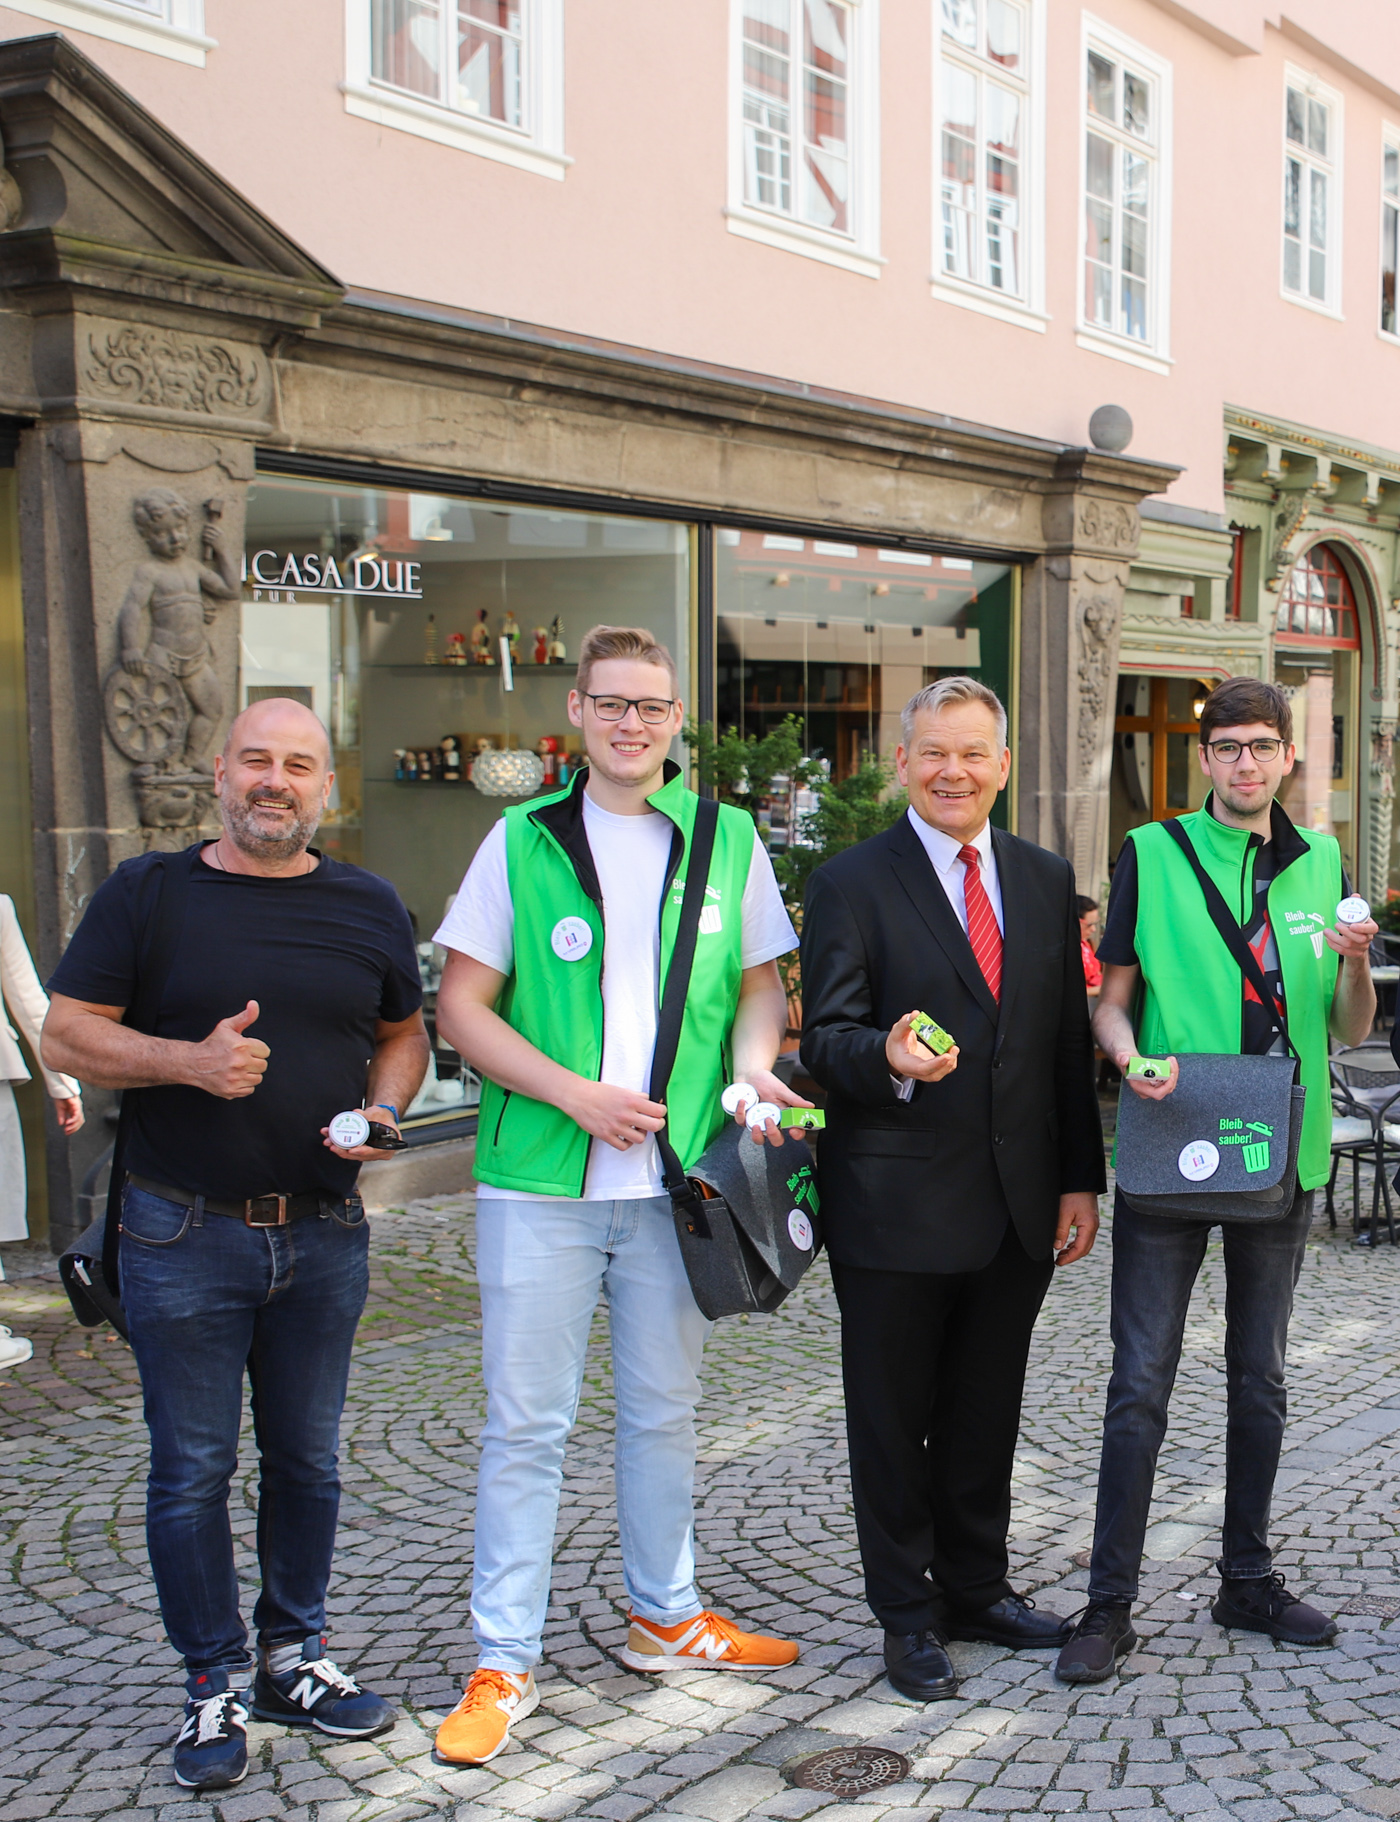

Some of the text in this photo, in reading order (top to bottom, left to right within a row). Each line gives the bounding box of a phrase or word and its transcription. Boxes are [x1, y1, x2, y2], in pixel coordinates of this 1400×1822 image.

[252, 549, 344, 588] CASA
[354, 558, 423, 594] DUE
[672, 878, 686, 890] Ble
[1284, 910, 1306, 922] Bleib
[1289, 922, 1316, 936] sauber!
[1219, 1117, 1243, 1131] Bleib
[1218, 1132, 1253, 1146] sauber!
[688, 1632, 732, 1662] N
[288, 1674, 329, 1711] N
